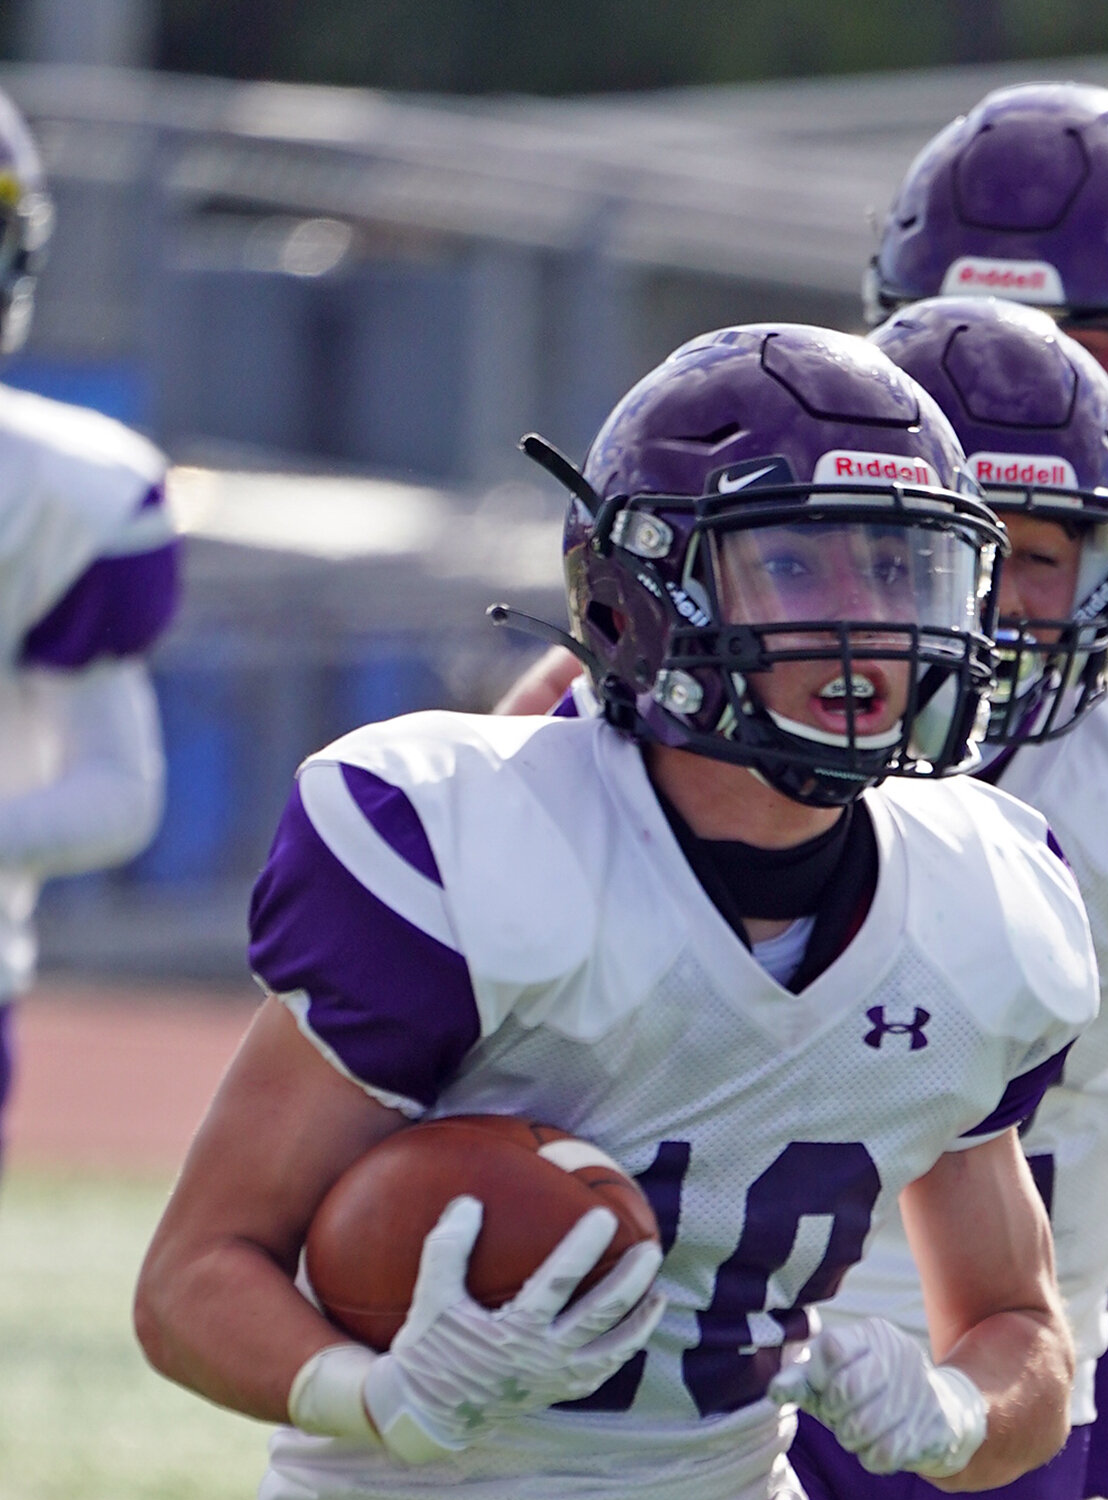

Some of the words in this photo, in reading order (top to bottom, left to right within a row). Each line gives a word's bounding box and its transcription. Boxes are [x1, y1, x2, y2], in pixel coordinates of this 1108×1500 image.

[958, 267, 1047, 290] Riddell
[835, 457, 930, 486] Riddell
[977, 461, 1066, 485] Riddell
